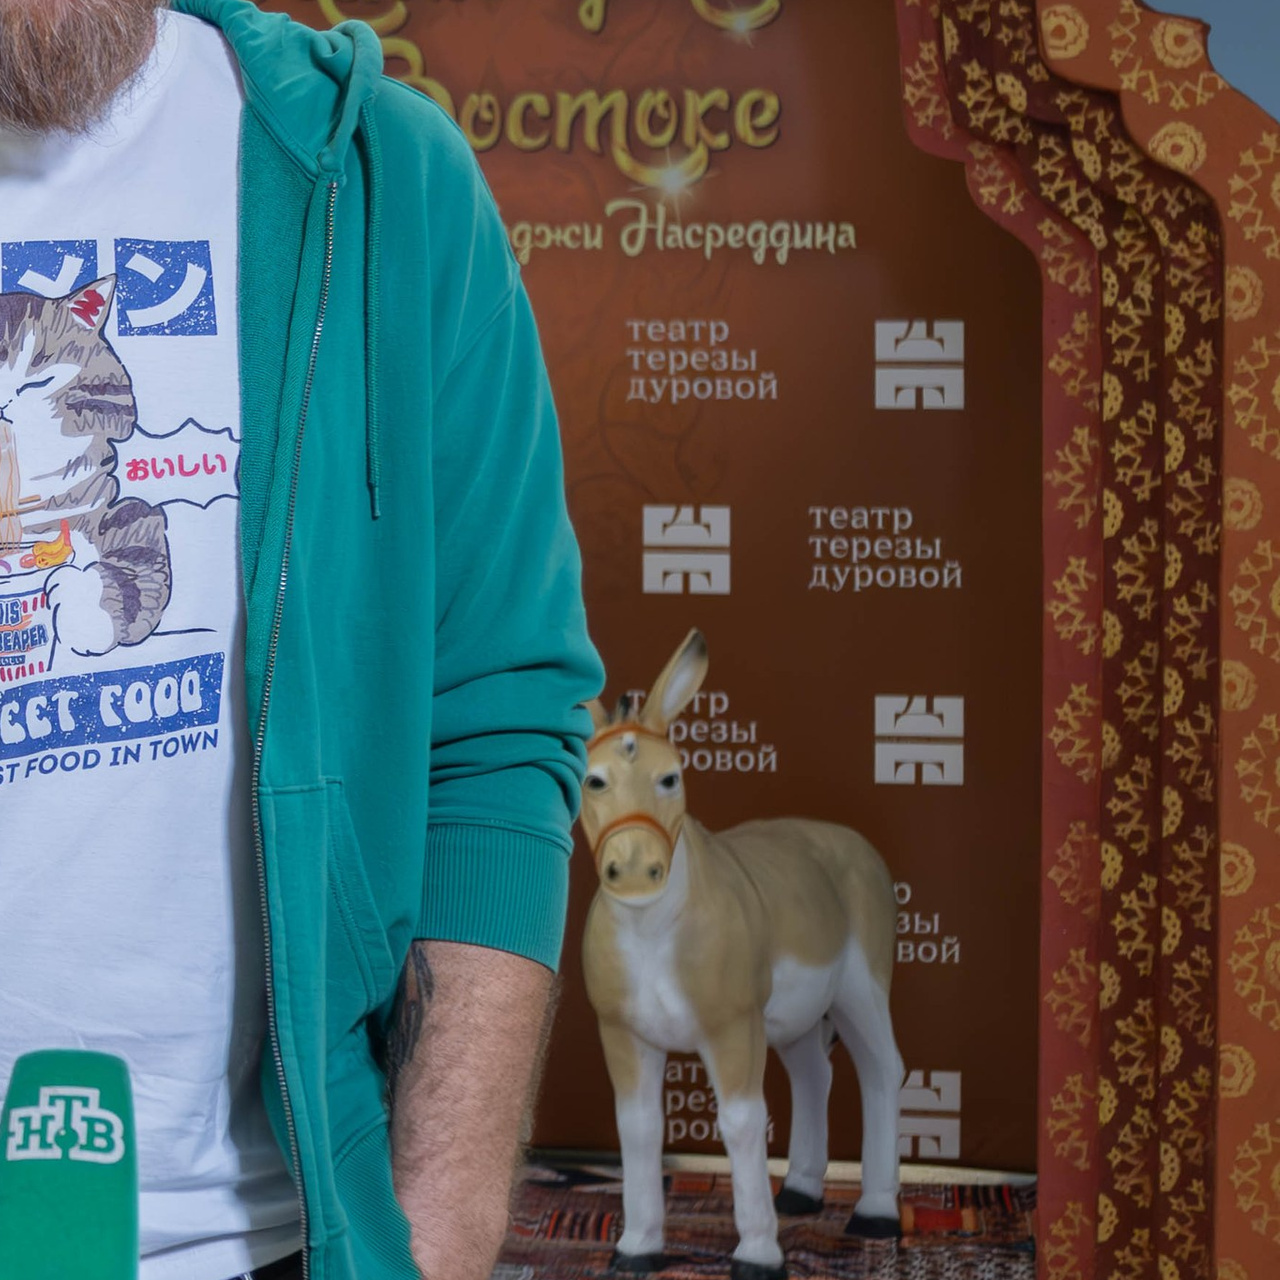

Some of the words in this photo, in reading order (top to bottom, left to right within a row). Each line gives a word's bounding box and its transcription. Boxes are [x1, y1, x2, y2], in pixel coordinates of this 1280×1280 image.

[605, 199, 857, 265] Насреддина
[626, 319, 730, 346] театр
[626, 348, 758, 375] терезы
[626, 372, 778, 404] дуровой
[125, 453, 227, 481] おいしい
[808, 506, 914, 535] театр
[808, 535, 942, 563] терезы
[808, 560, 963, 593] дуровой
[99, 670, 202, 728] FOOD
[24, 749, 101, 779] FOOD
[109, 742, 142, 766] IN
[150, 728, 220, 761] TOWN
[8, 1087, 124, 1163] НТВ
